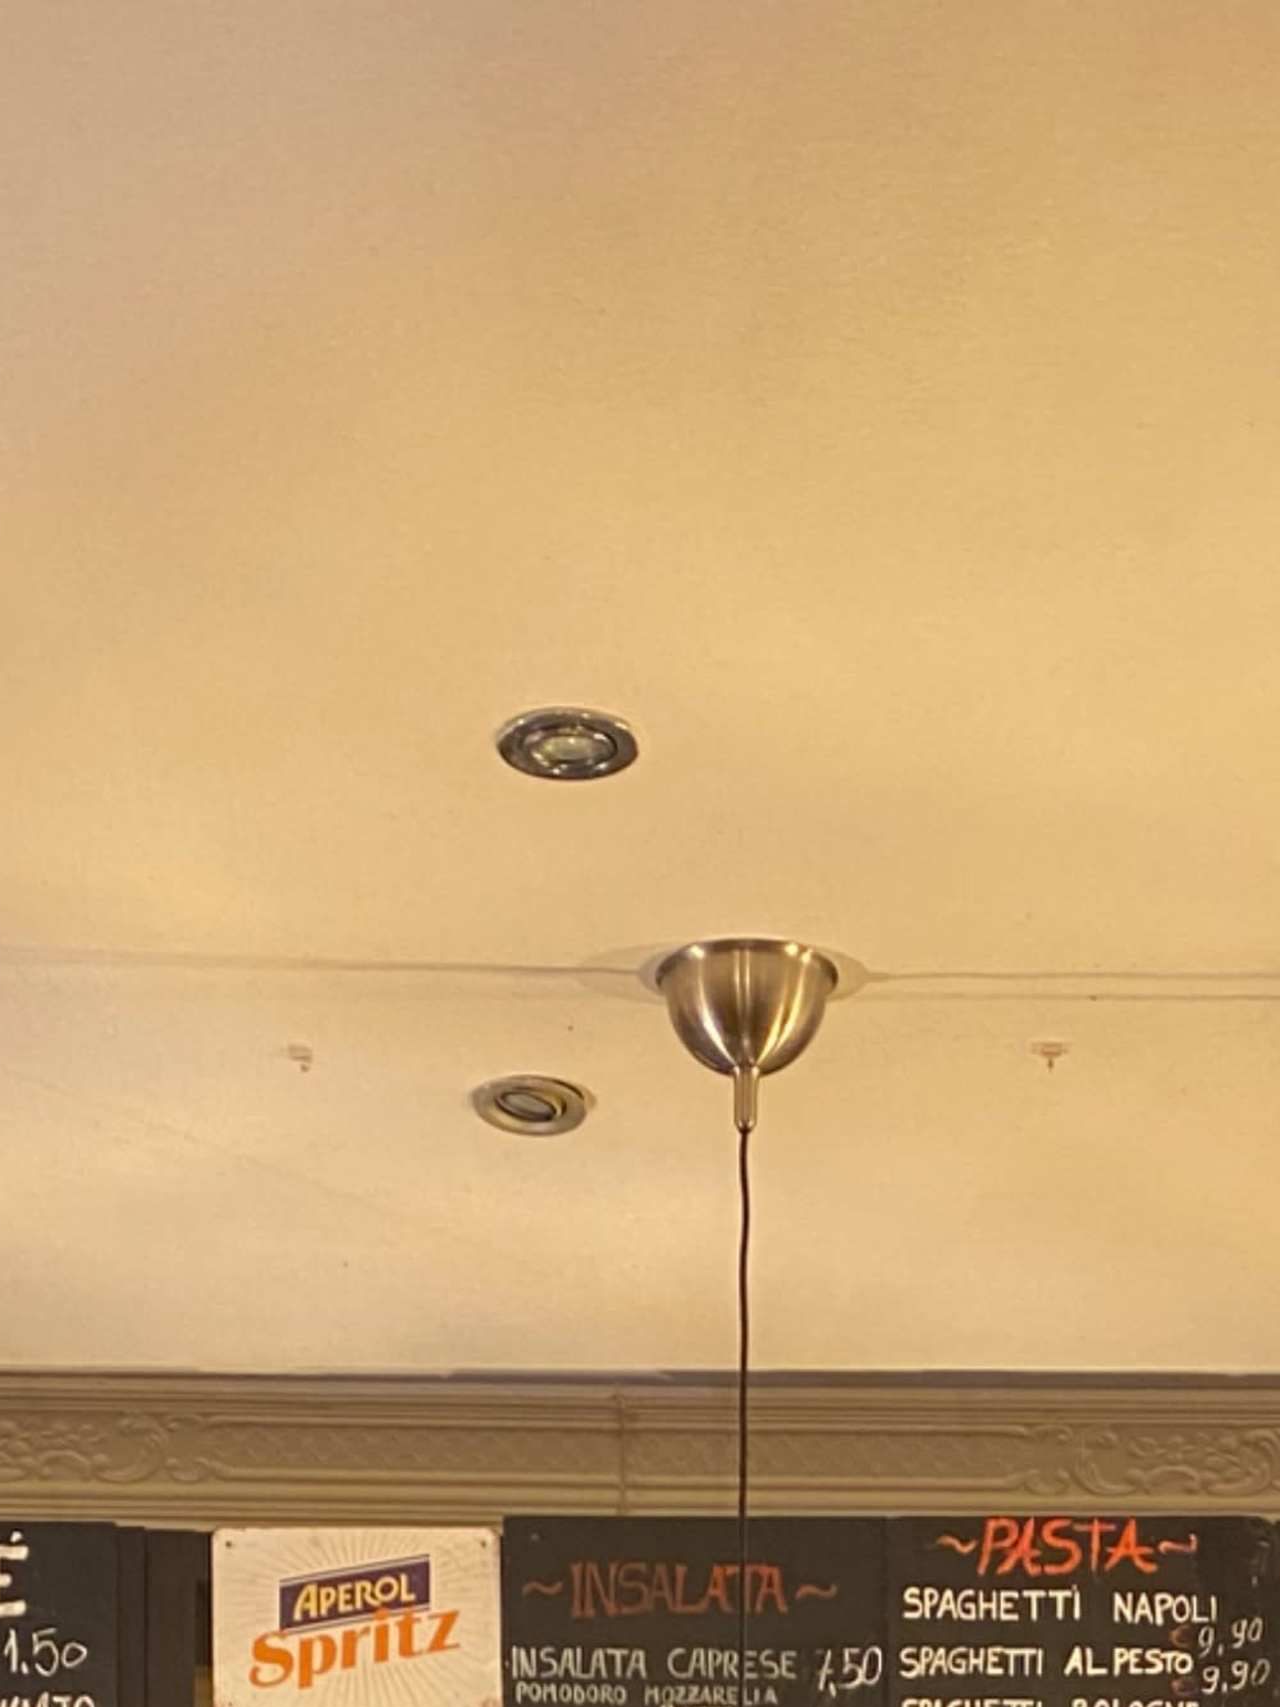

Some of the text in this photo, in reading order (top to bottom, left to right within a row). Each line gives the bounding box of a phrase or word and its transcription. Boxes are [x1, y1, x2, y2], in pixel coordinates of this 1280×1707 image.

[978, 1517, 1159, 1576] PASTA
[293, 1573, 416, 1621] APEROL
[570, 1562, 789, 1618] INSALATA
[903, 1584, 1217, 1627] SPAGHETTI NAPOLI
[248, 1604, 461, 1690] Spritz
[511, 1645, 797, 1681] INSALATA CAPRESE
[899, 1646, 1194, 1679] SPAGHETTI AL PESTO
[515, 1680, 628, 1705] POMODORO
